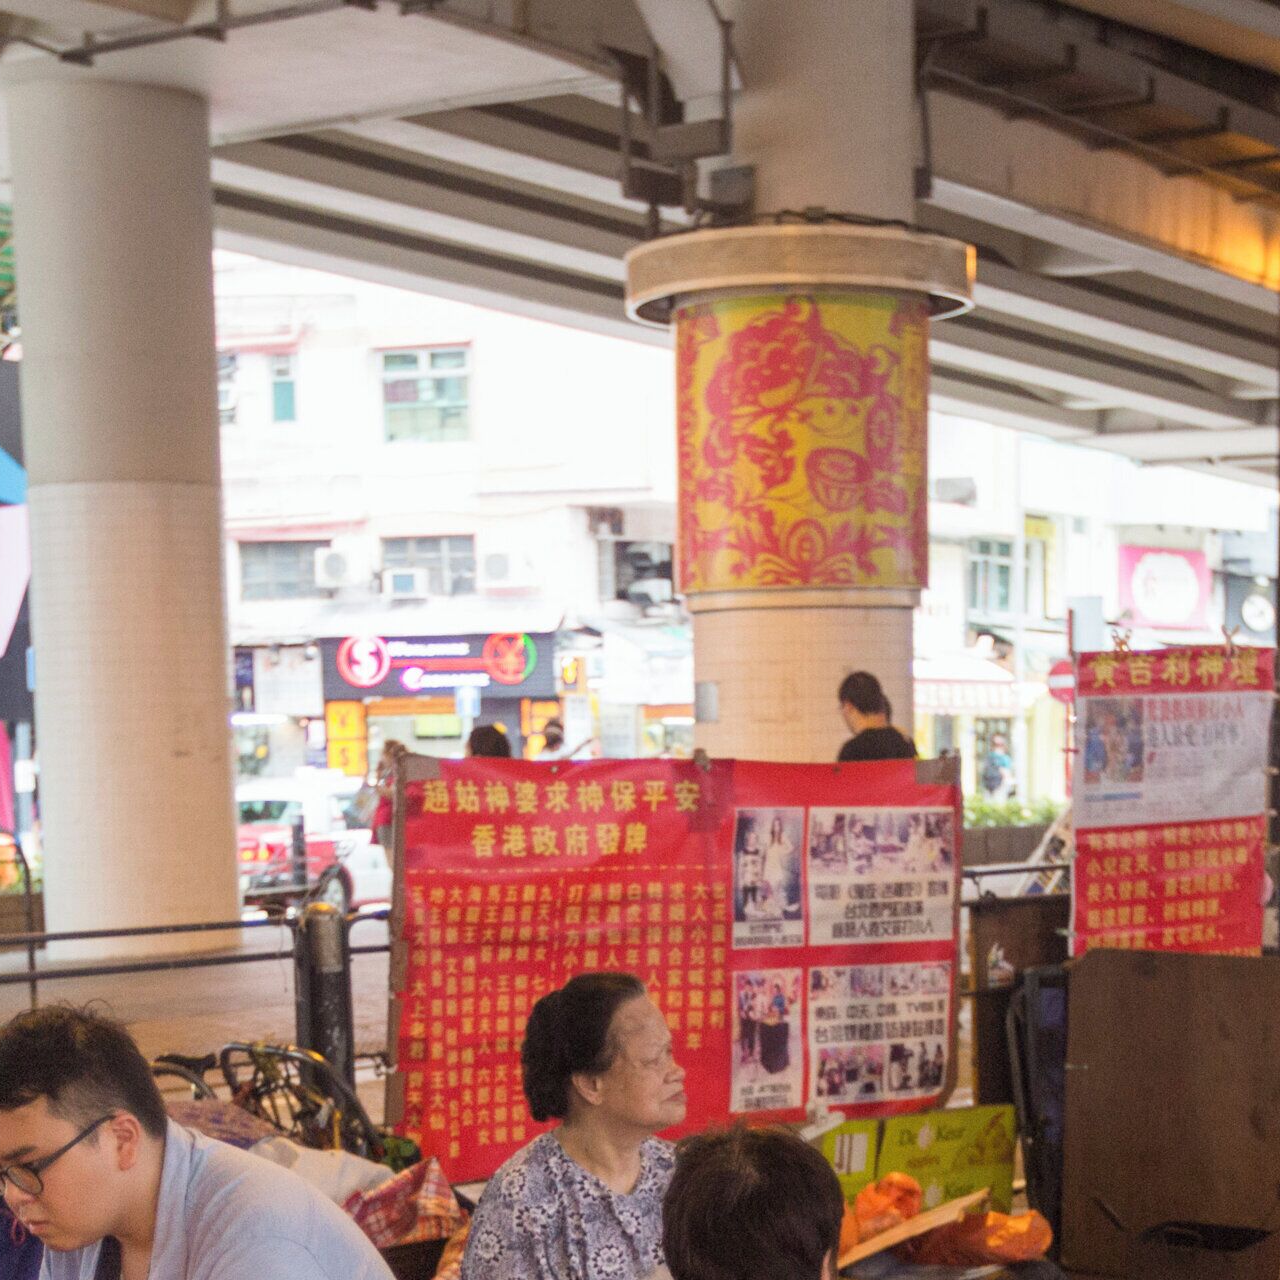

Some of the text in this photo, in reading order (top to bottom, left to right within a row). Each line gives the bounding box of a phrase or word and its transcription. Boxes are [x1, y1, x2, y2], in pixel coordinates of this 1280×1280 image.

[472, 822, 647, 857] 香港政府發牌
